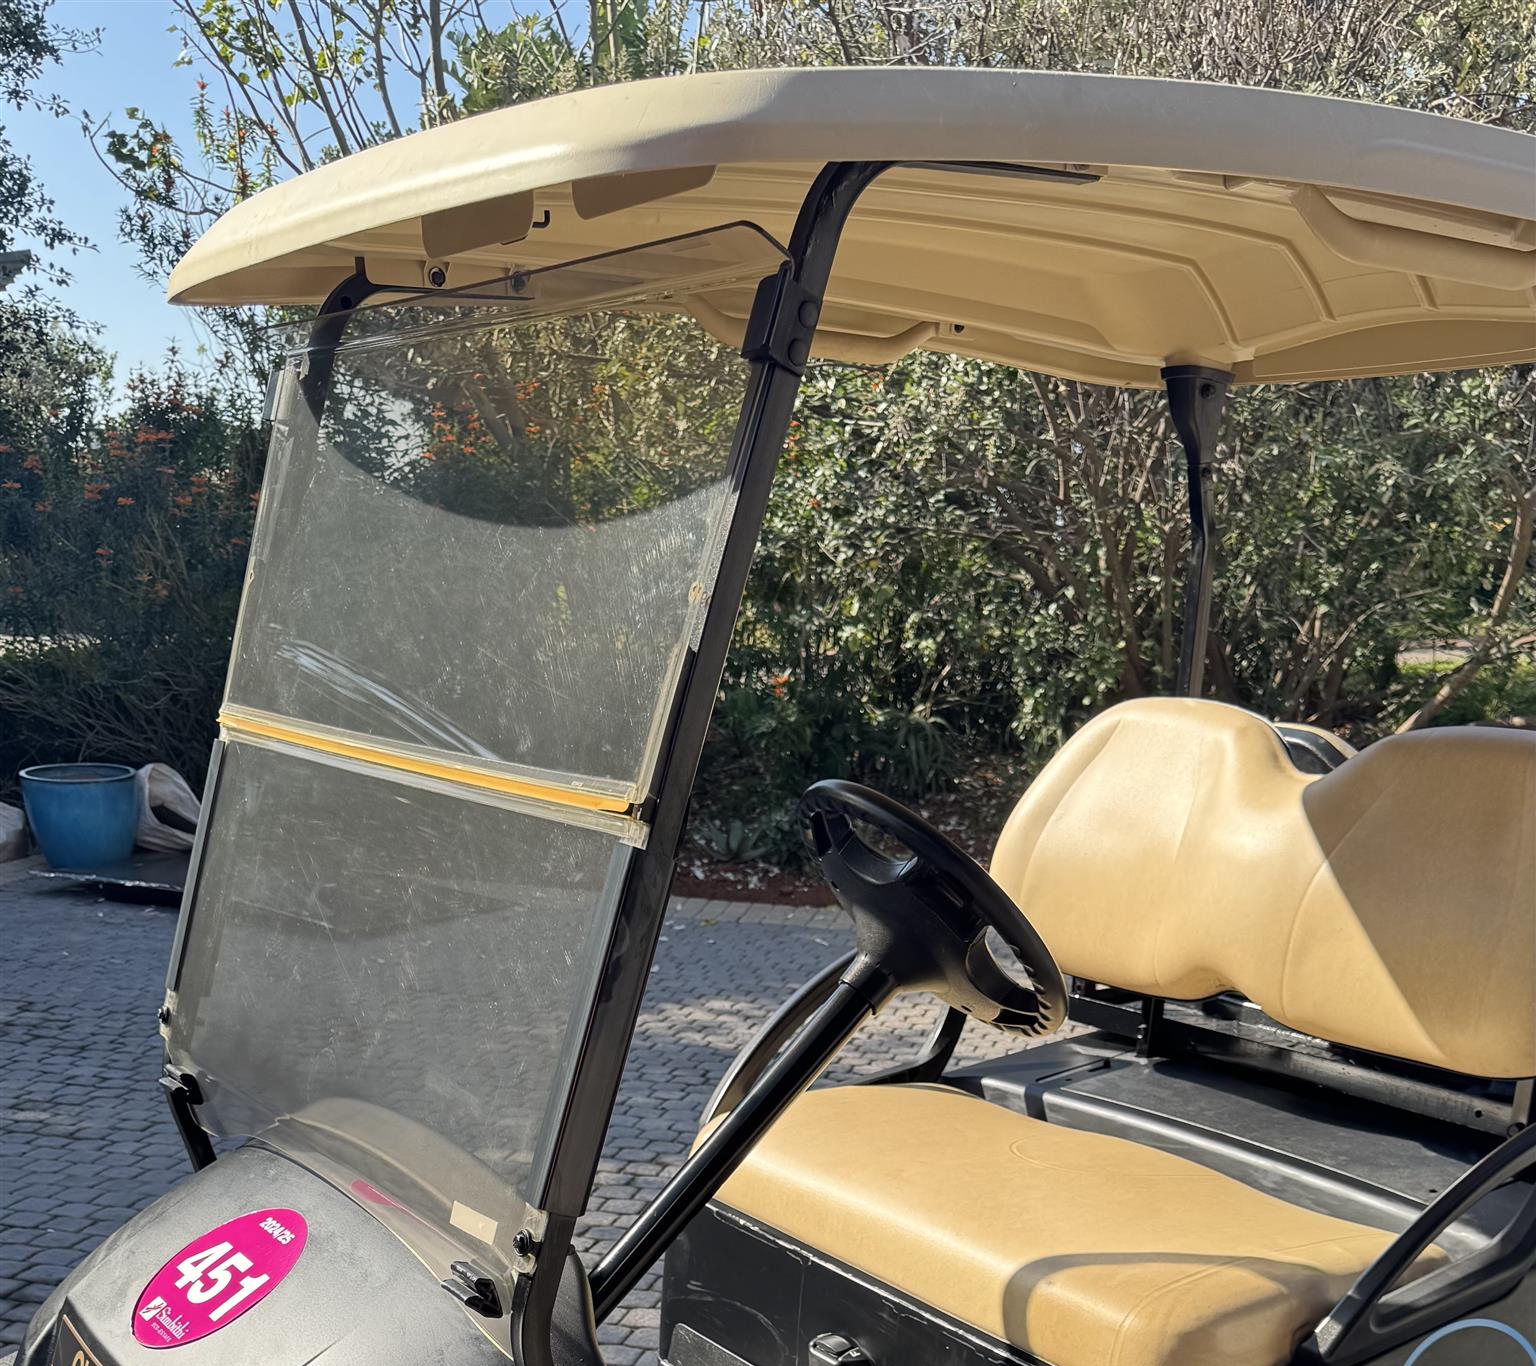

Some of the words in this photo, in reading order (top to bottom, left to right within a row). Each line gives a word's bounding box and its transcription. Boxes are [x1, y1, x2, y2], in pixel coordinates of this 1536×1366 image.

[258, 1216, 296, 1245] 2024/25
[173, 1241, 271, 1322] 451
[155, 1306, 190, 1340] Simbithi
